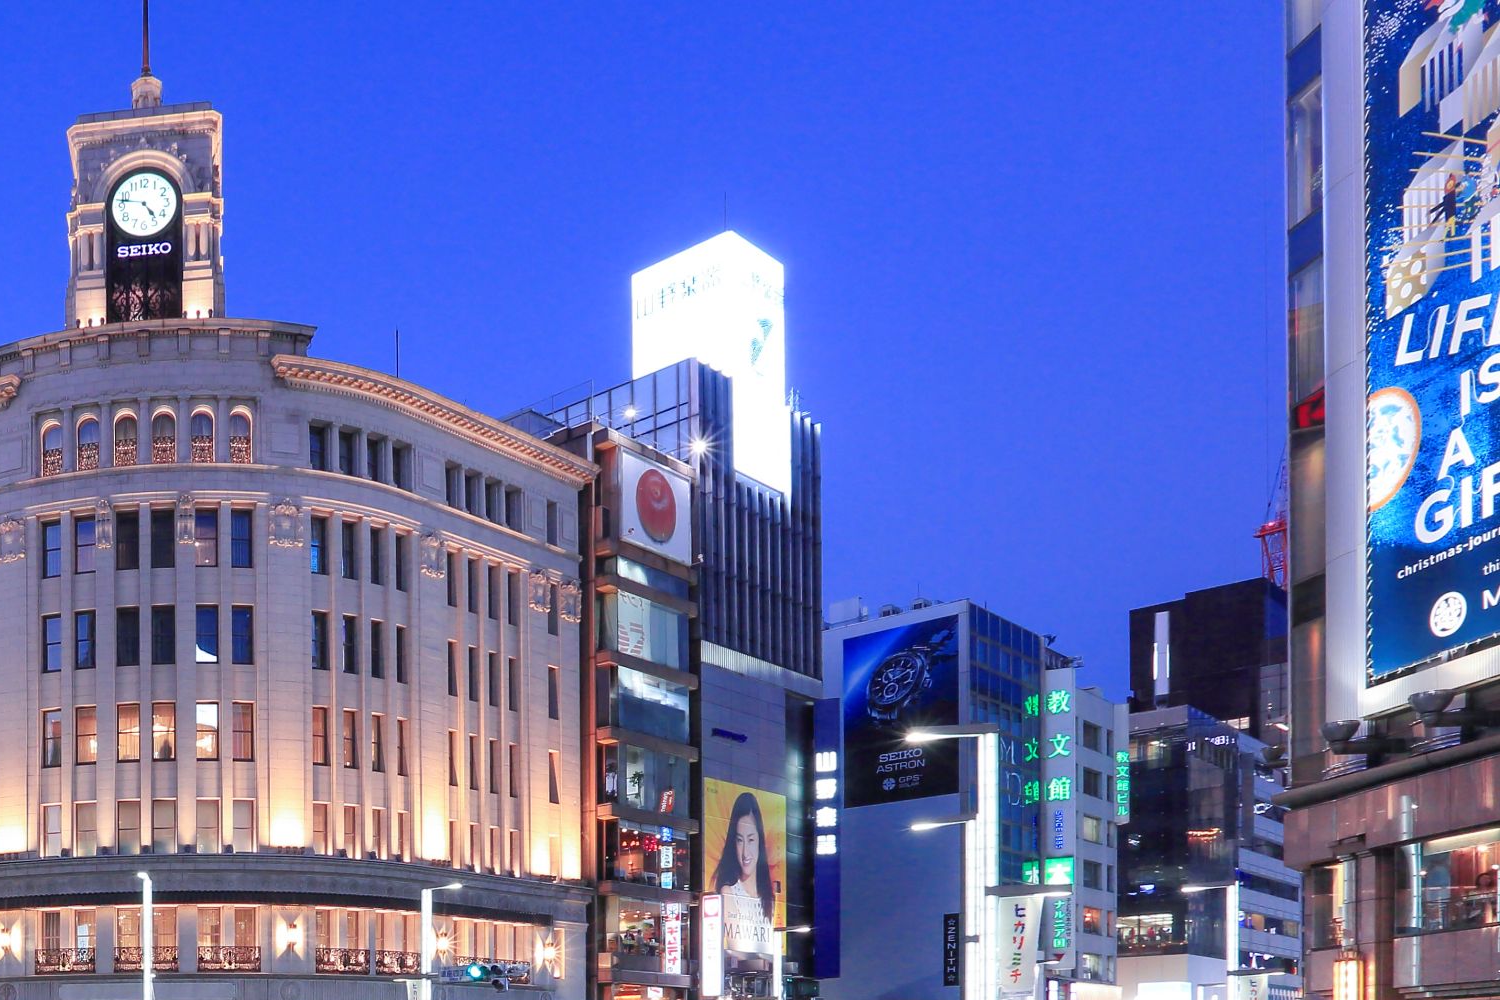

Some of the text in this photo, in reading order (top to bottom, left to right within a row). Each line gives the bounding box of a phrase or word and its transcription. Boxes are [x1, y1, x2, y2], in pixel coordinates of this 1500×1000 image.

[130, 182, 138, 191] 11
[140, 179, 149, 189] 12
[121, 191, 130, 201] 10
[160, 187, 167, 197] 2
[118, 202, 126, 212] 9
[164, 198, 170, 208] 3
[122, 212, 130, 222] 8
[159, 209, 166, 218] 4
[131, 218, 138, 229] 7
[140, 220, 148, 230] 6
[151, 217, 158, 227] 5
[117, 242, 172, 258] SEIKO
[1438, 428, 1475, 480] A
[1048, 690, 1071, 802] 教文館
[879, 748, 923, 763] SEIKO
[876, 758, 926, 774] ASTRON
[898, 774, 920, 783] GPS
[1116, 751, 1129, 816] 教文館ビル
[1053, 900, 1066, 949] ナルニア国
[1010, 904, 1026, 983] ヒカリミチ
[947, 926, 956, 973] ZENITH
[440, 968, 466, 978] 銀座四丁
